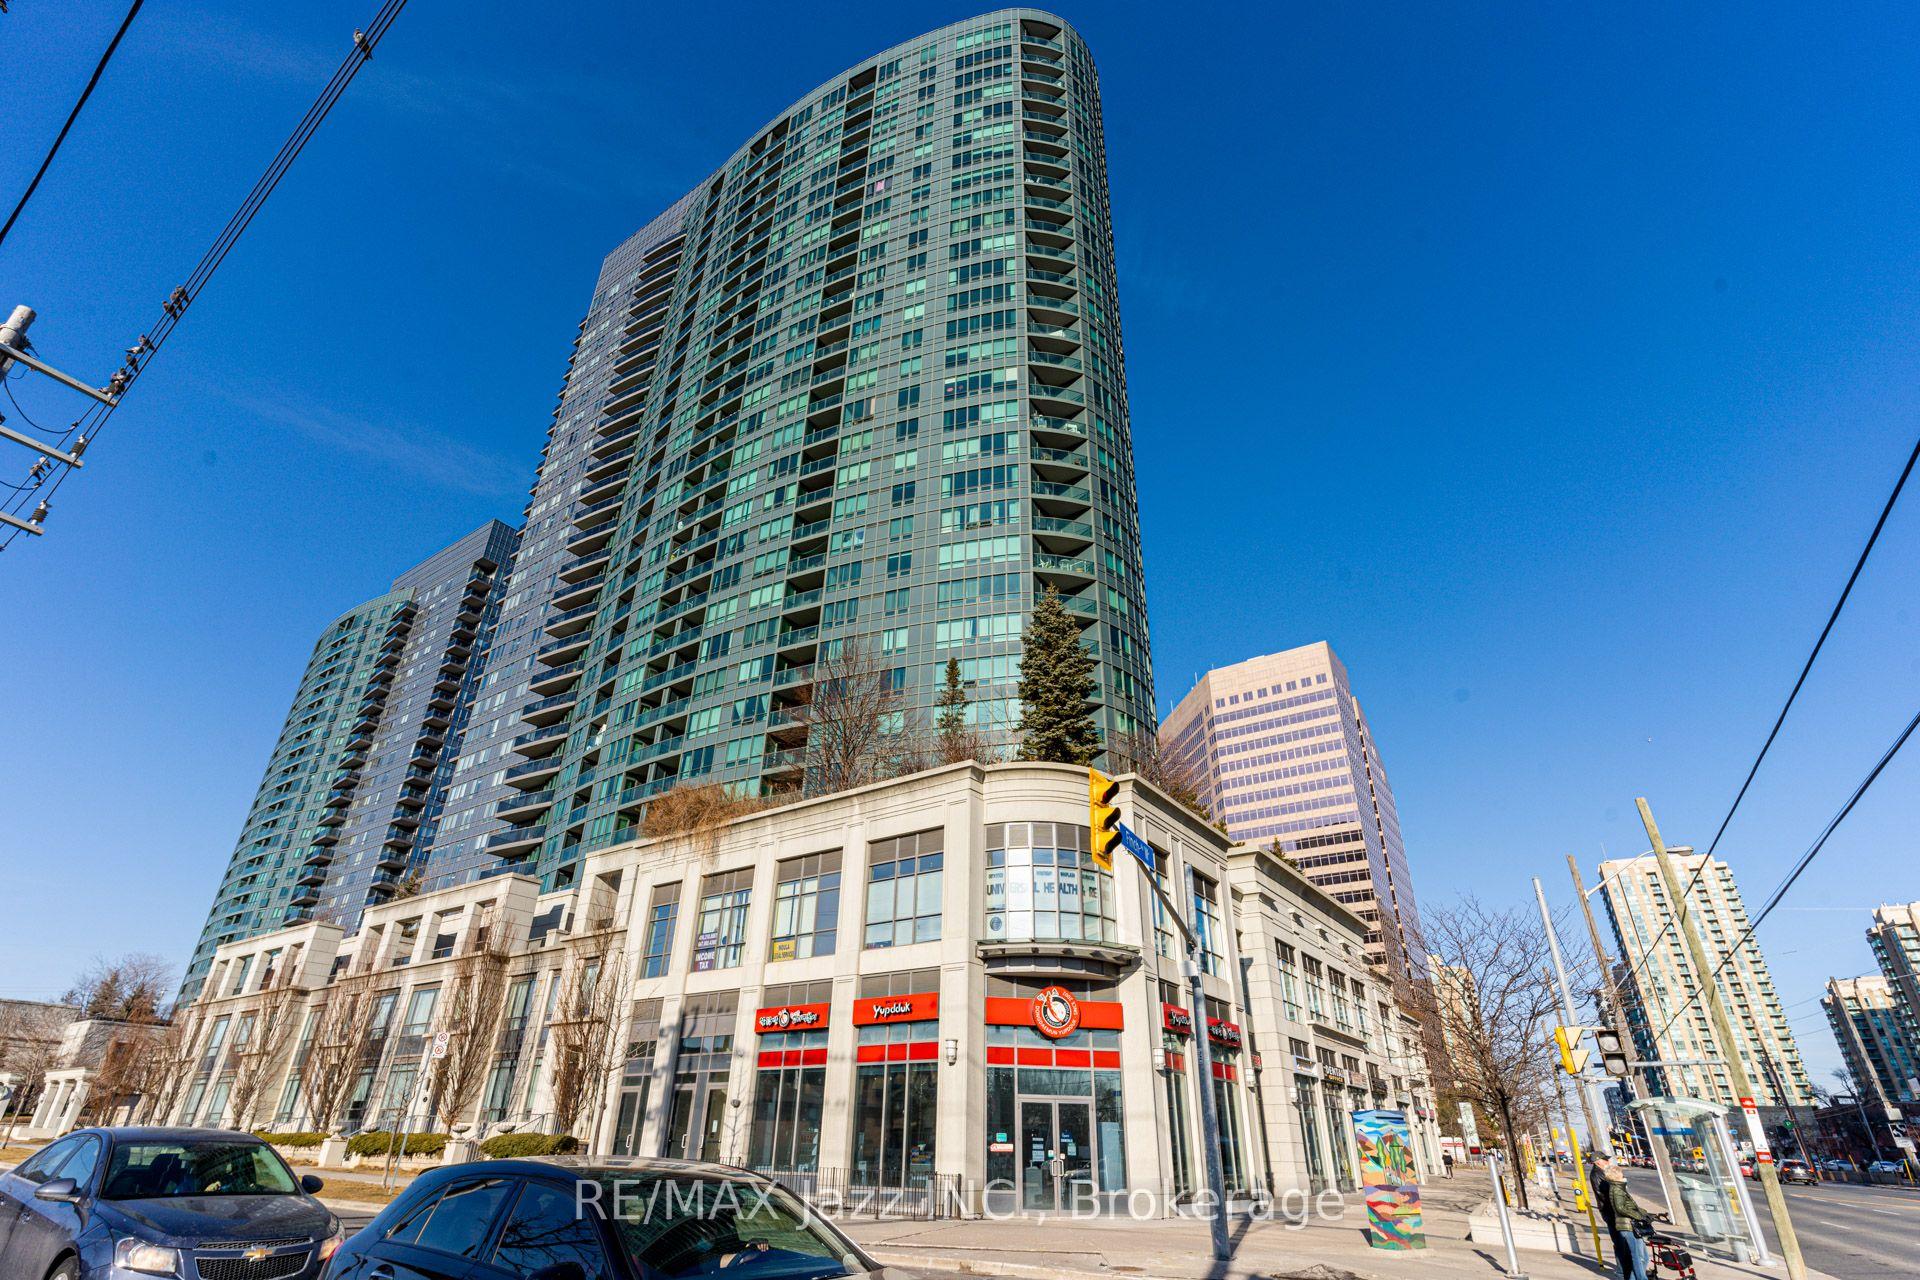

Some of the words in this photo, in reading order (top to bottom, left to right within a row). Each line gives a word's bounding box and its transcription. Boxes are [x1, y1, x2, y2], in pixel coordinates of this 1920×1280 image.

[695, 951, 715, 961] INCOME
[699, 961, 709, 970] TAX
[872, 1002, 911, 1019] Yupdduk
